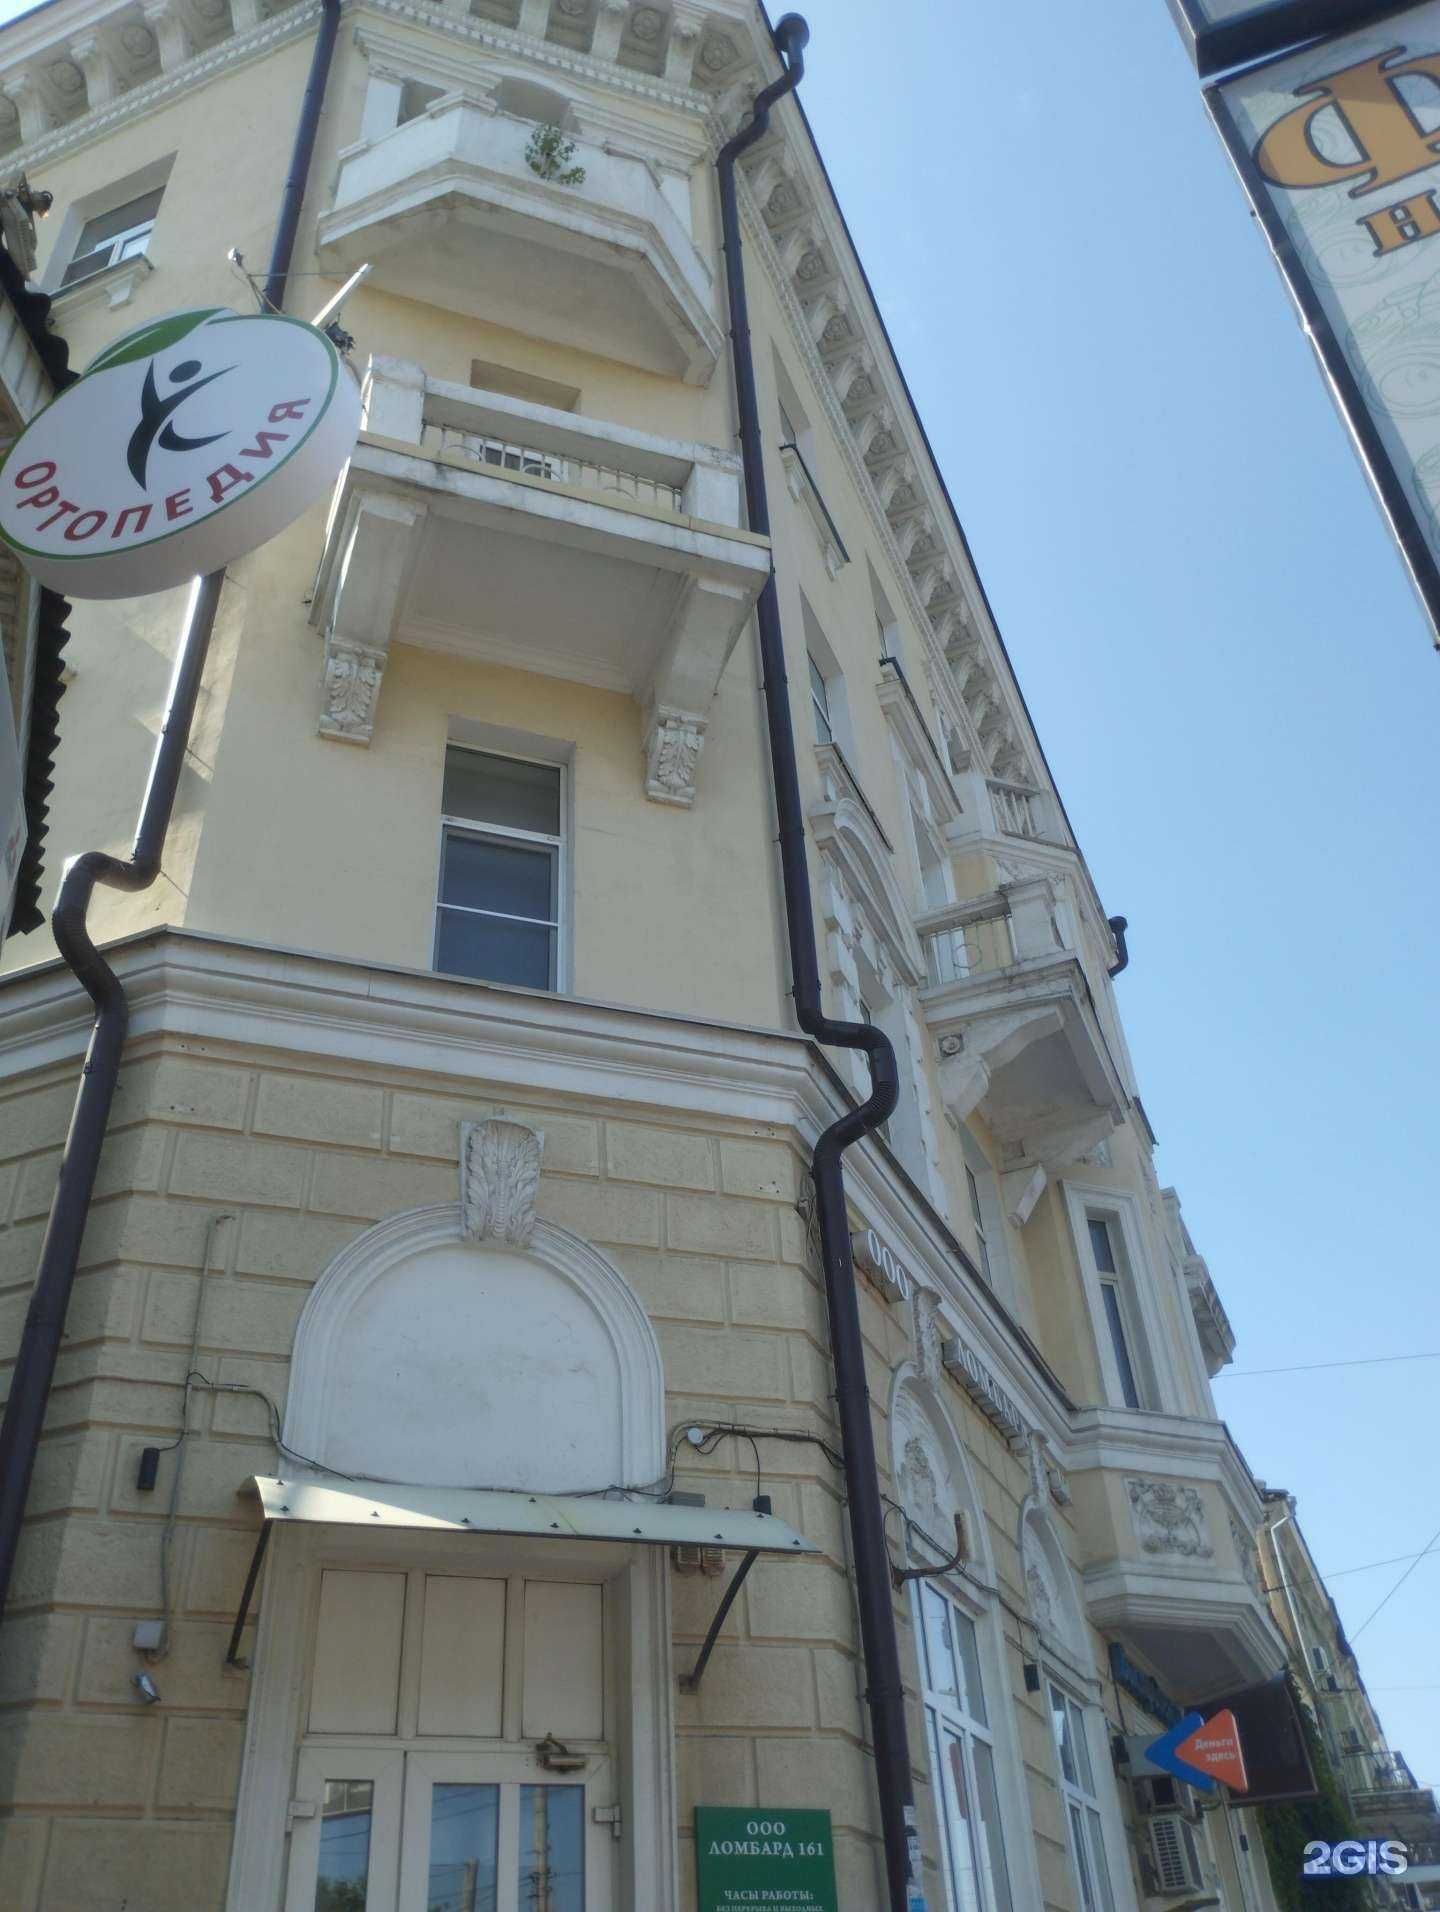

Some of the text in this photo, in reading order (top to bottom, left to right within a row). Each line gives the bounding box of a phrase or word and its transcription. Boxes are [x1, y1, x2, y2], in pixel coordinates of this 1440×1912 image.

[14, 398, 311, 541] ОРТОПЕДИЯ
[1195, 1738, 1233, 1751] Деньги
[746, 1821, 785, 1836] ООО
[708, 1841, 825, 1859] ЛОМБАРД 161
[724, 1890, 814, 1901] ЧАСЫ РАБОТЫ:
